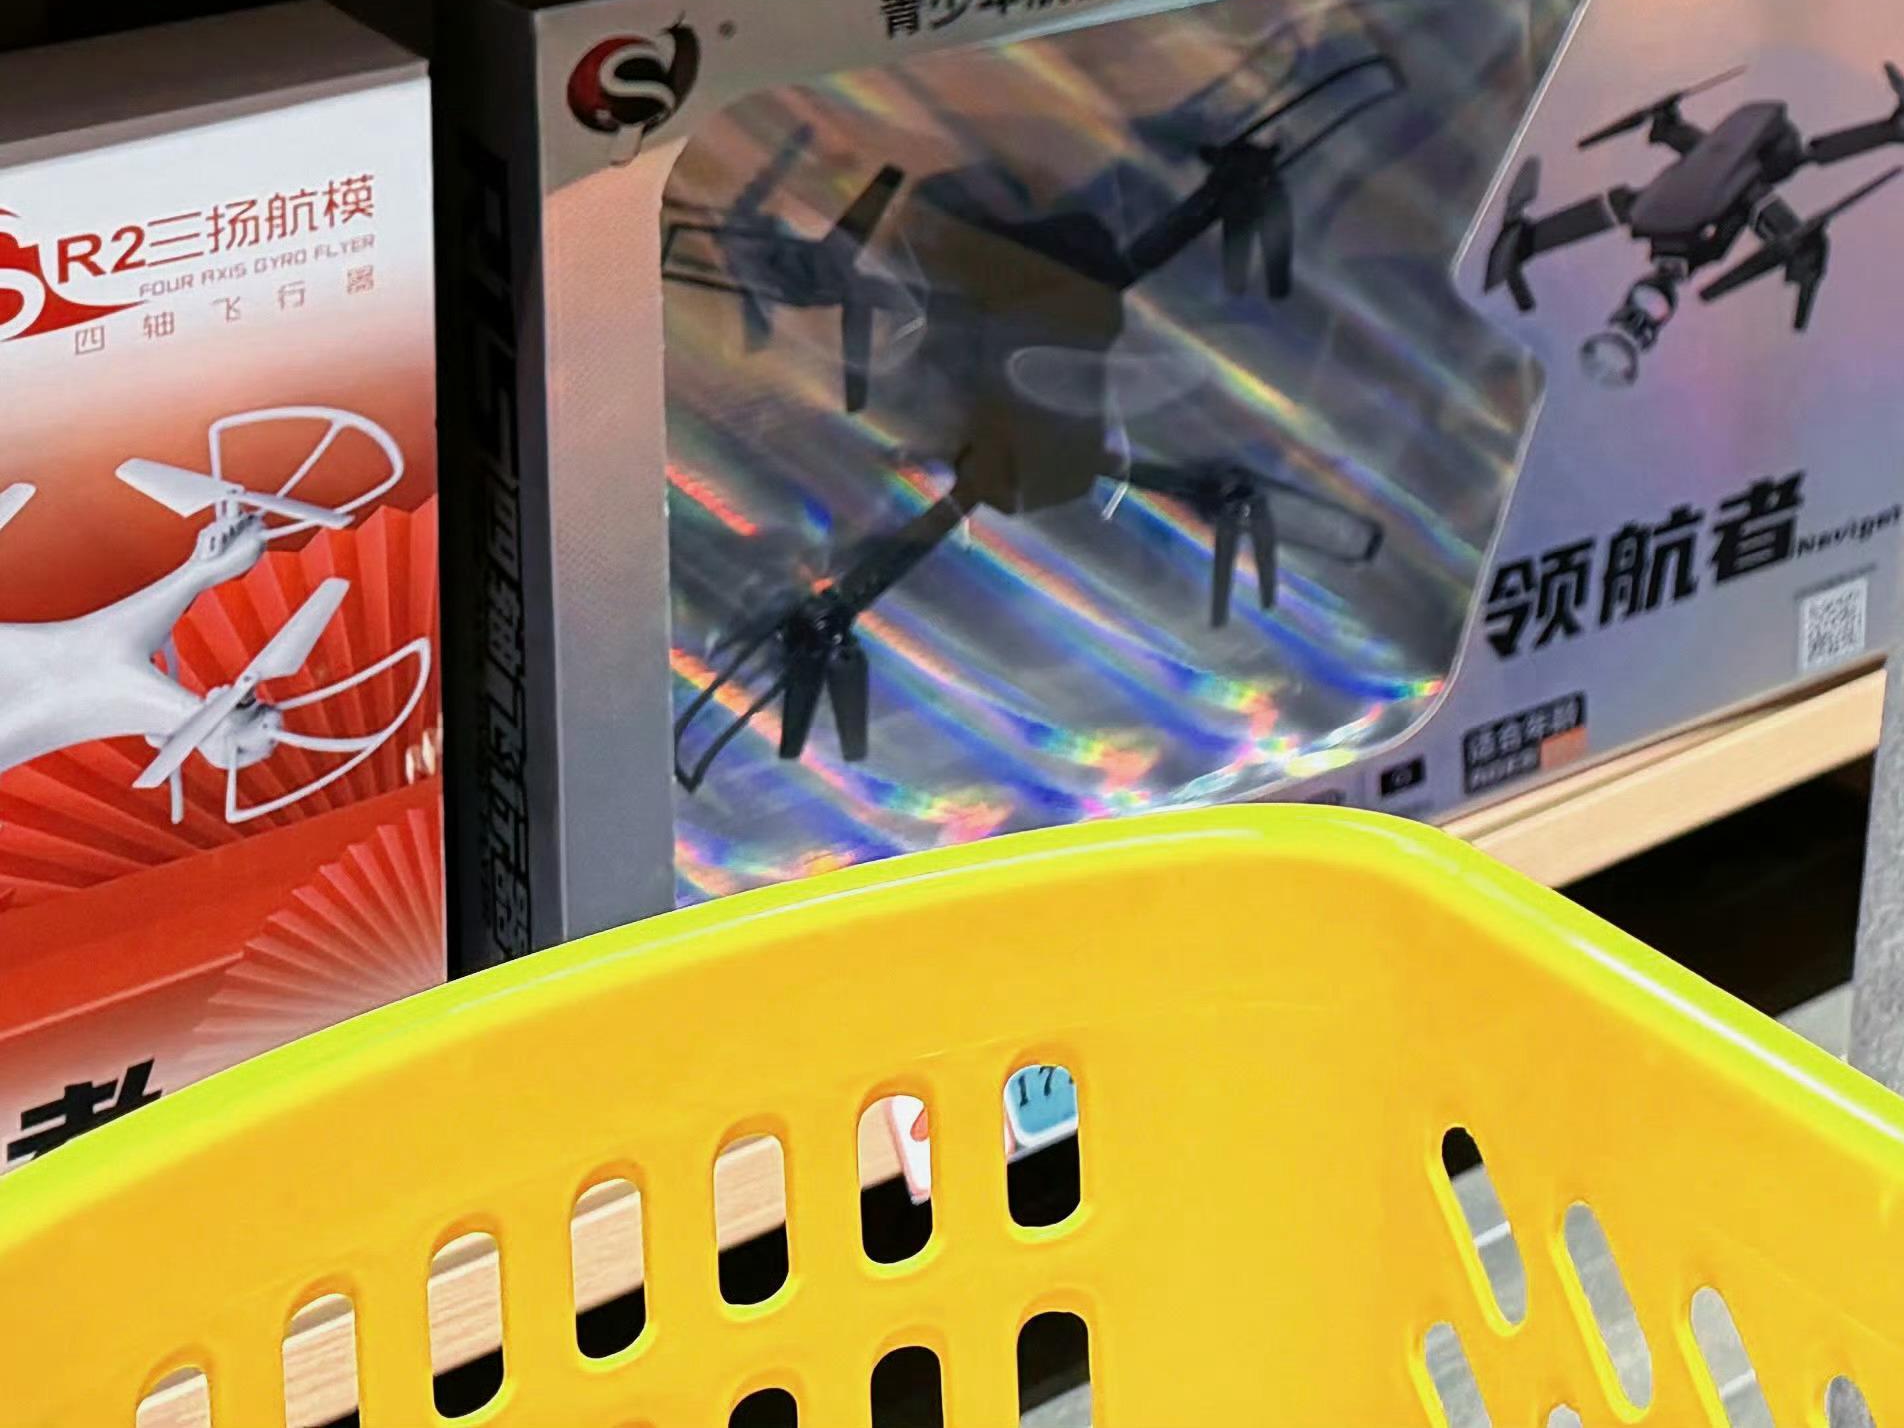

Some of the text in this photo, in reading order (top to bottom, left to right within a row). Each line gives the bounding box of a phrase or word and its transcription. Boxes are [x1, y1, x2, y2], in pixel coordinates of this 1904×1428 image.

[139, 234, 375, 298] FOUR AXIS GYRO FLYER
[1484, 472, 1804, 659] 领航者
